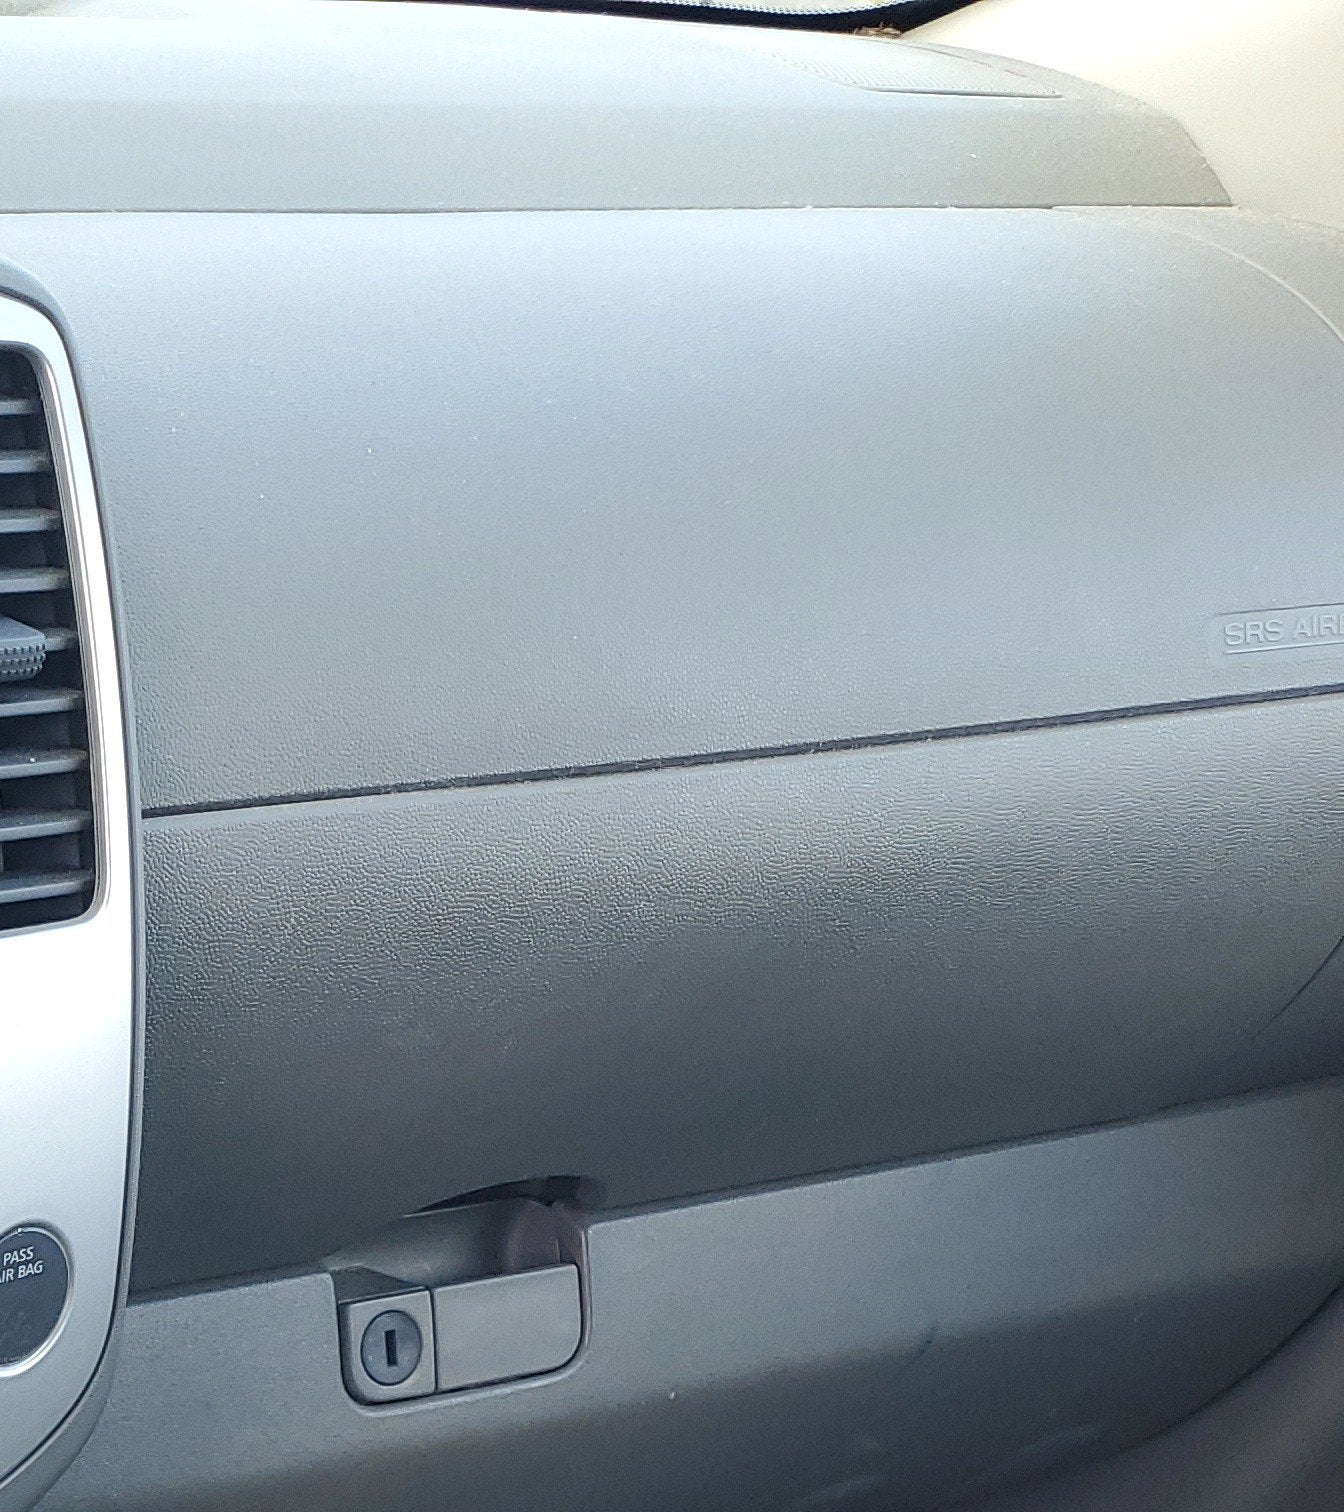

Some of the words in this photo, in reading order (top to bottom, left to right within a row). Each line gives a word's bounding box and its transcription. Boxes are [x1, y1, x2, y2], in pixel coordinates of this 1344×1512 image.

[1224, 620, 1284, 645] SRS
[2, 1246, 34, 1265] PASS
[18, 1262, 43, 1278] BAG
